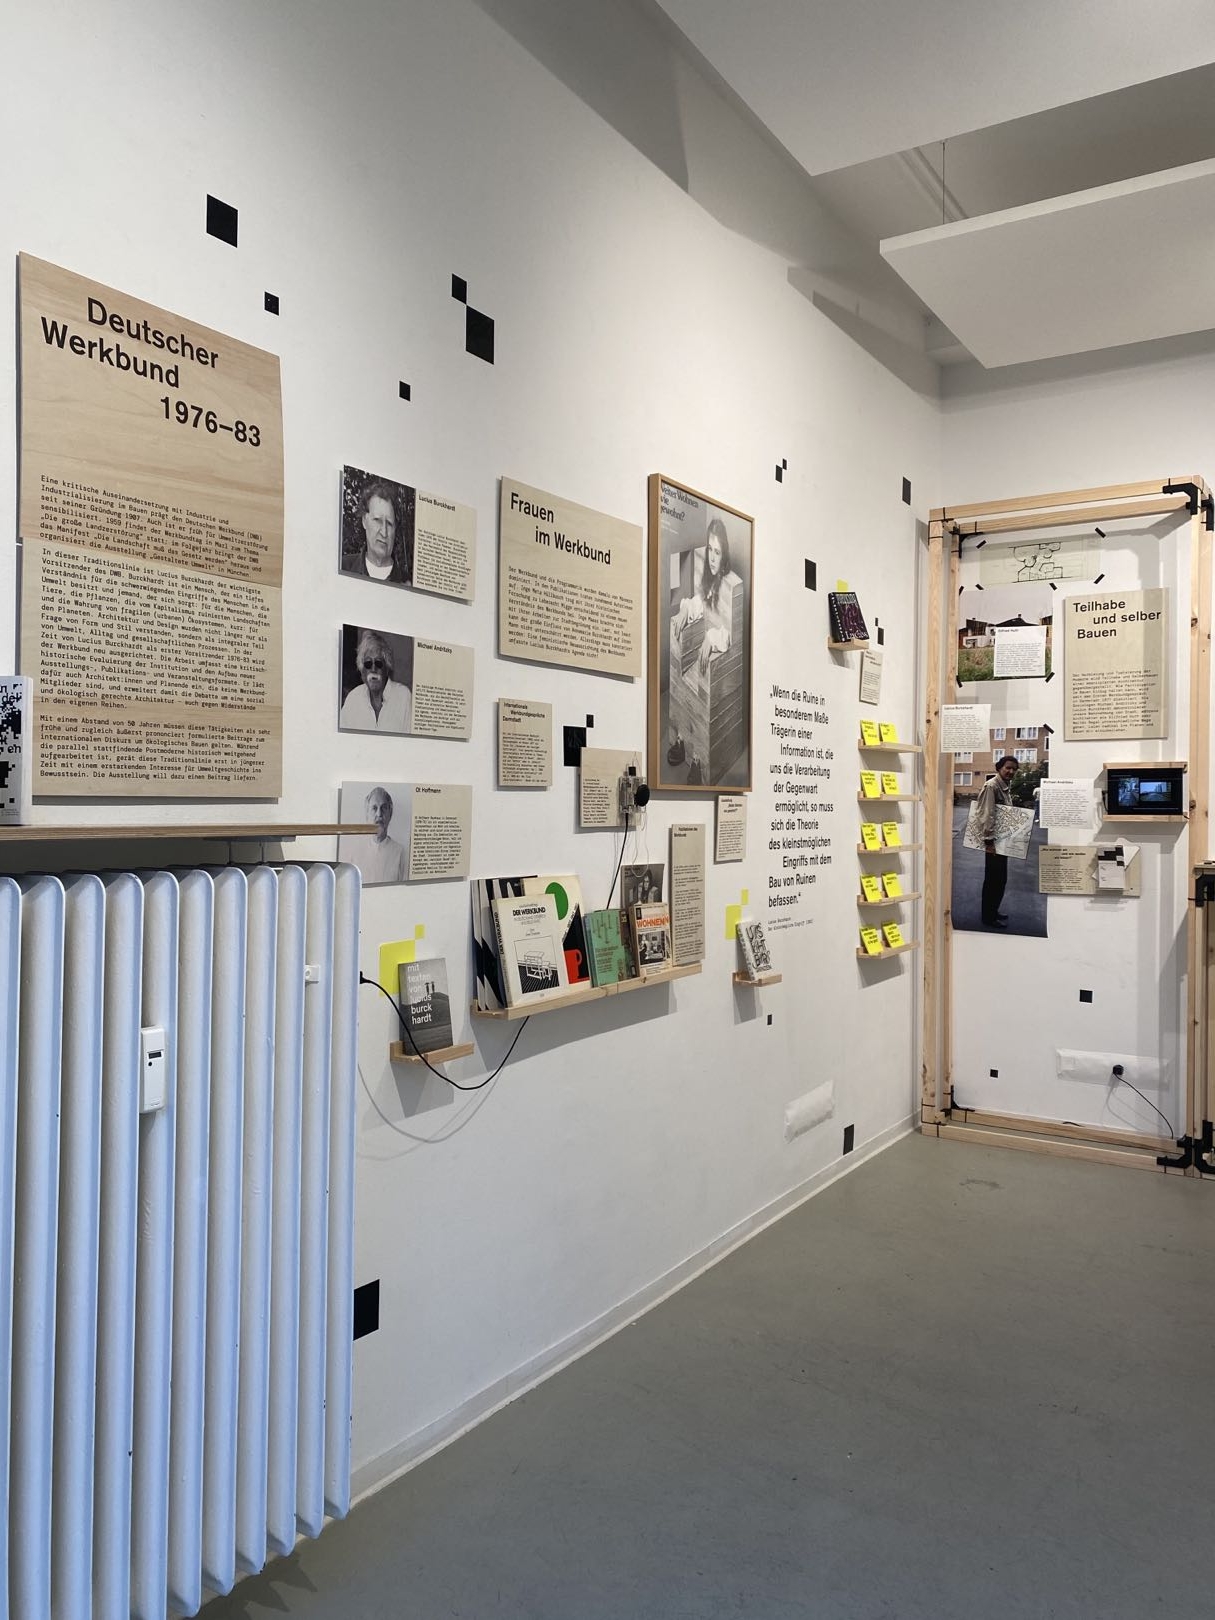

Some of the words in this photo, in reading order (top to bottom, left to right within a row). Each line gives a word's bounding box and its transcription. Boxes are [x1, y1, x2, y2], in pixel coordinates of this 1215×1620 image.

[88, 297, 218, 368] Deutscher
[41, 316, 180, 388] Werkbund
[510, 492, 554, 523] Frauen
[535, 526, 550, 546] im
[554, 532, 610, 564] Werkbund
[1073, 600, 1126, 612] Teilhabe
[1093, 613, 1116, 624] und
[1120, 611, 1161, 622] selber
[1078, 628, 1116, 639] Bauen
[792, 689, 800, 701] die
[802, 690, 818, 704] Ruine
[820, 694, 826, 706] in
[775, 704, 812, 722] besonderem
[771, 722, 796, 738] Trägerin
[798, 727, 812, 740] einer
[780, 743, 814, 758] Information
[825, 748, 834, 760] die
[770, 764, 781, 774] uns
[783, 763, 792, 774] die
[794, 763, 830, 779] Verarbeitung
[774, 780, 784, 792] der
[786, 781, 818, 796] Gegenwart
[810, 803, 818, 812] so
[818, 803, 834, 812] muss
[771, 819, 784, 830] sich
[786, 819, 796, 830] die
[797, 818, 818, 830] Theorie
[768, 838, 780, 850] des
[782, 836, 830, 850] kleinstmöglichen
[782, 855, 808, 870] Eingriffs
[810, 854, 818, 866] mit
[820, 854, 832, 864] dem
[768, 876, 781, 888] Bau
[782, 877, 794, 886] von
[796, 873, 816, 885] Ruinen
[521, 907, 546, 915] WERKBUND
[411, 1003, 432, 1014] burck
[412, 1014, 432, 1024] hardt
